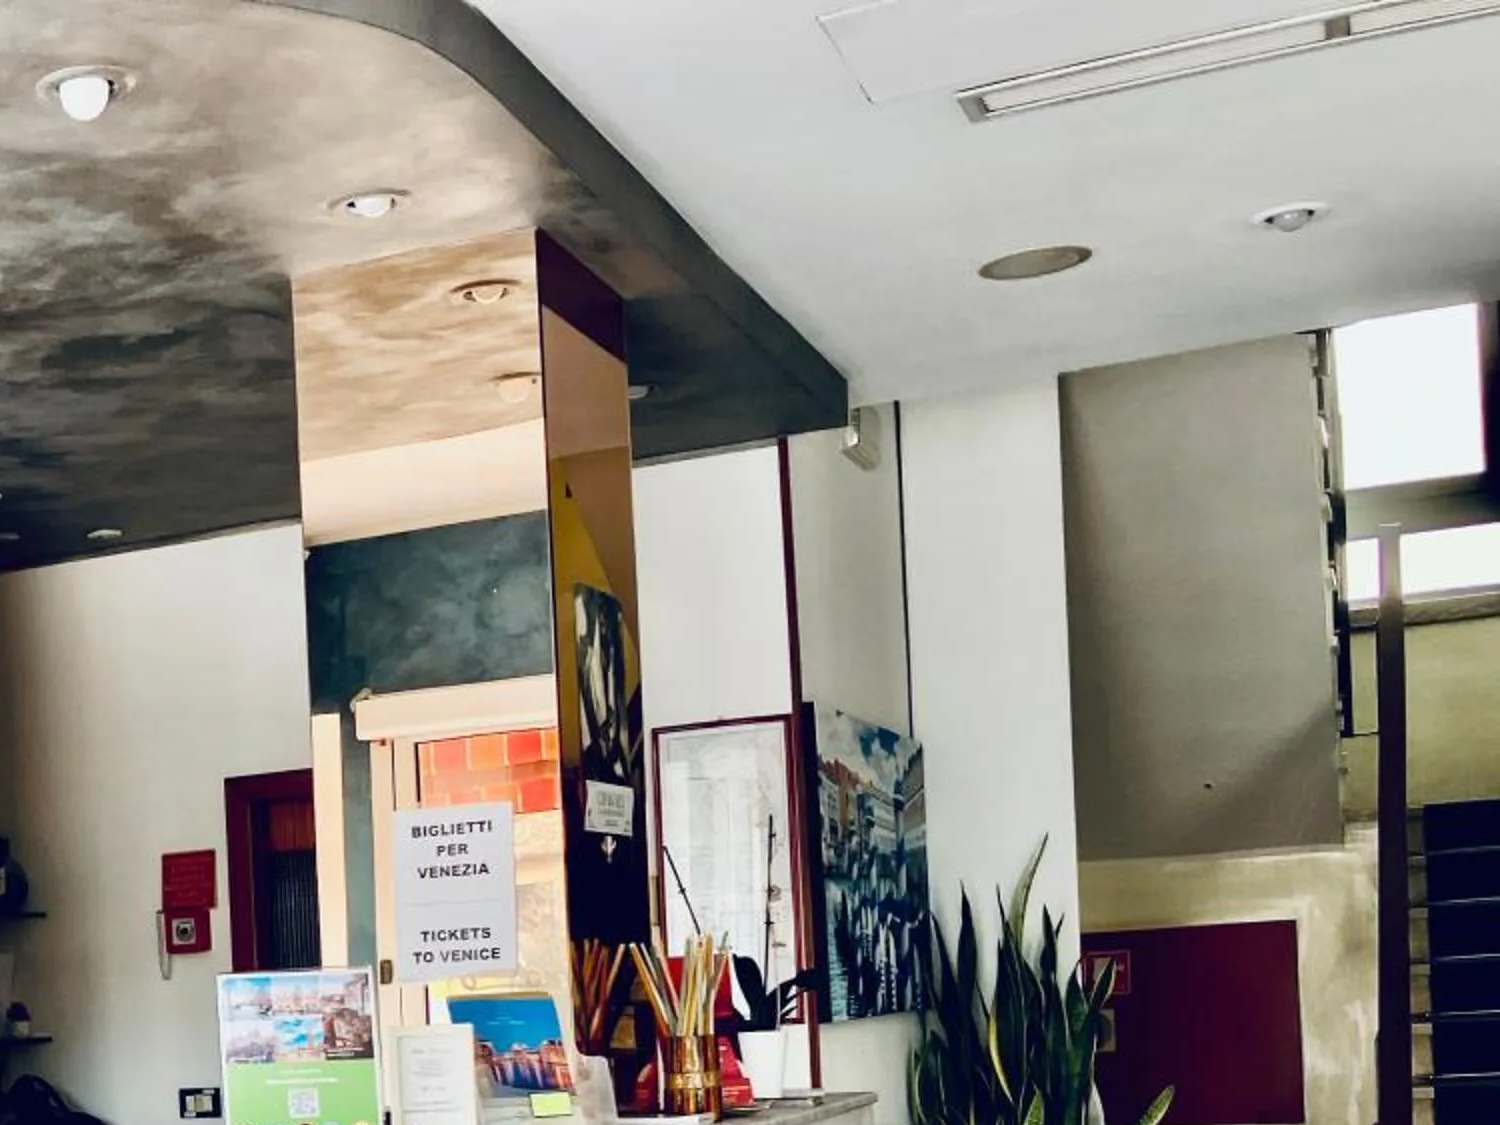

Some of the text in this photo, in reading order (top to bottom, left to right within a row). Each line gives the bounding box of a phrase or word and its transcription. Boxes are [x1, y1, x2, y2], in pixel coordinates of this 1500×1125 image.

[411, 820, 493, 838] BIGLIETTI
[436, 843, 469, 857] PER
[417, 863, 490, 879] VENEZIA
[420, 927, 492, 943] TICKETS
[412, 947, 501, 965] TO VENICE
